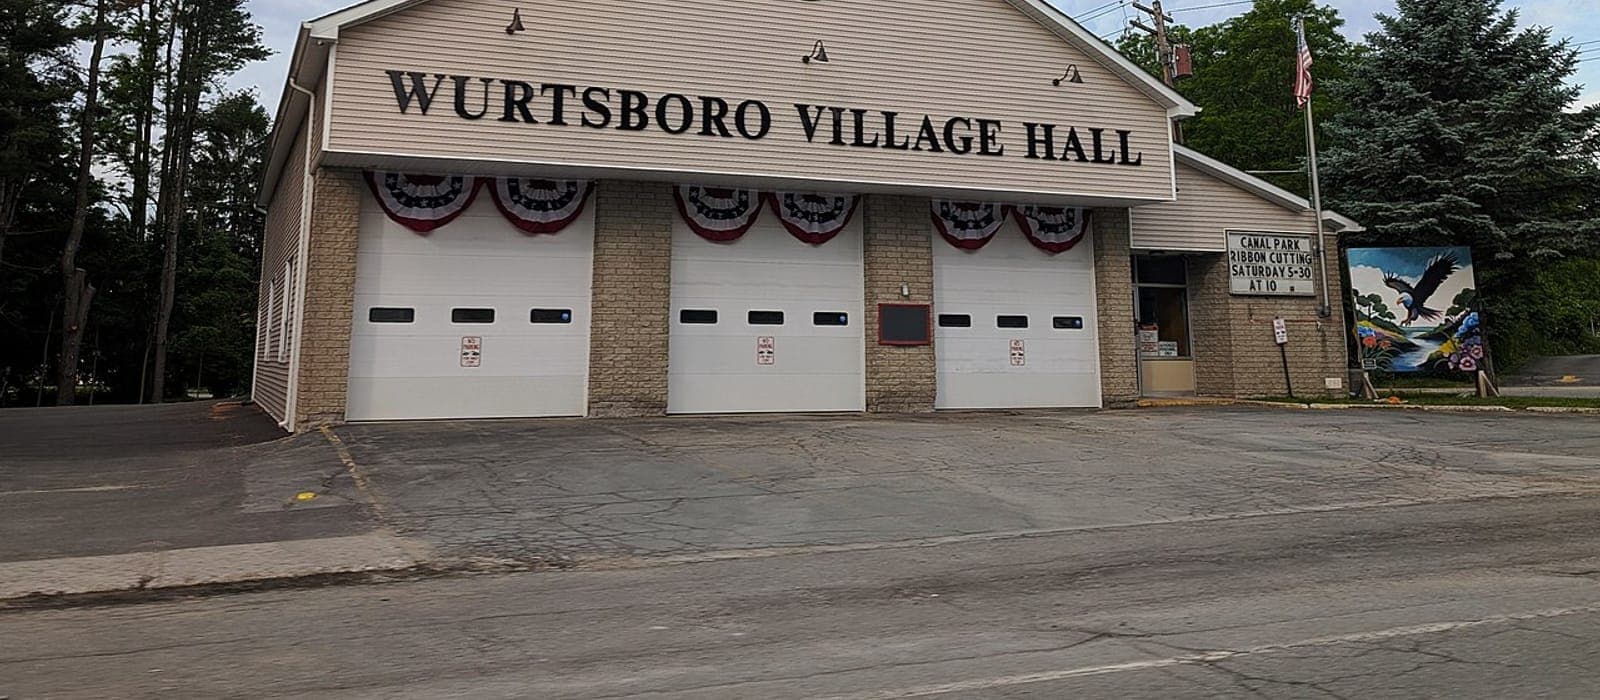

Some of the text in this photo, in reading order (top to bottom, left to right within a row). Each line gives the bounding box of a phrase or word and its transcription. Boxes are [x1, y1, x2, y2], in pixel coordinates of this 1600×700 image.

[385, 70, 1142, 166] WURTSBORO VILLAGE HALL
[1240, 236, 1300, 250] CANAL PARK
[1230, 250, 1312, 264] RIBBON CUTTING
[1232, 264, 1311, 278] SATURDAY 5-30
[1249, 280, 1262, 291] AT
